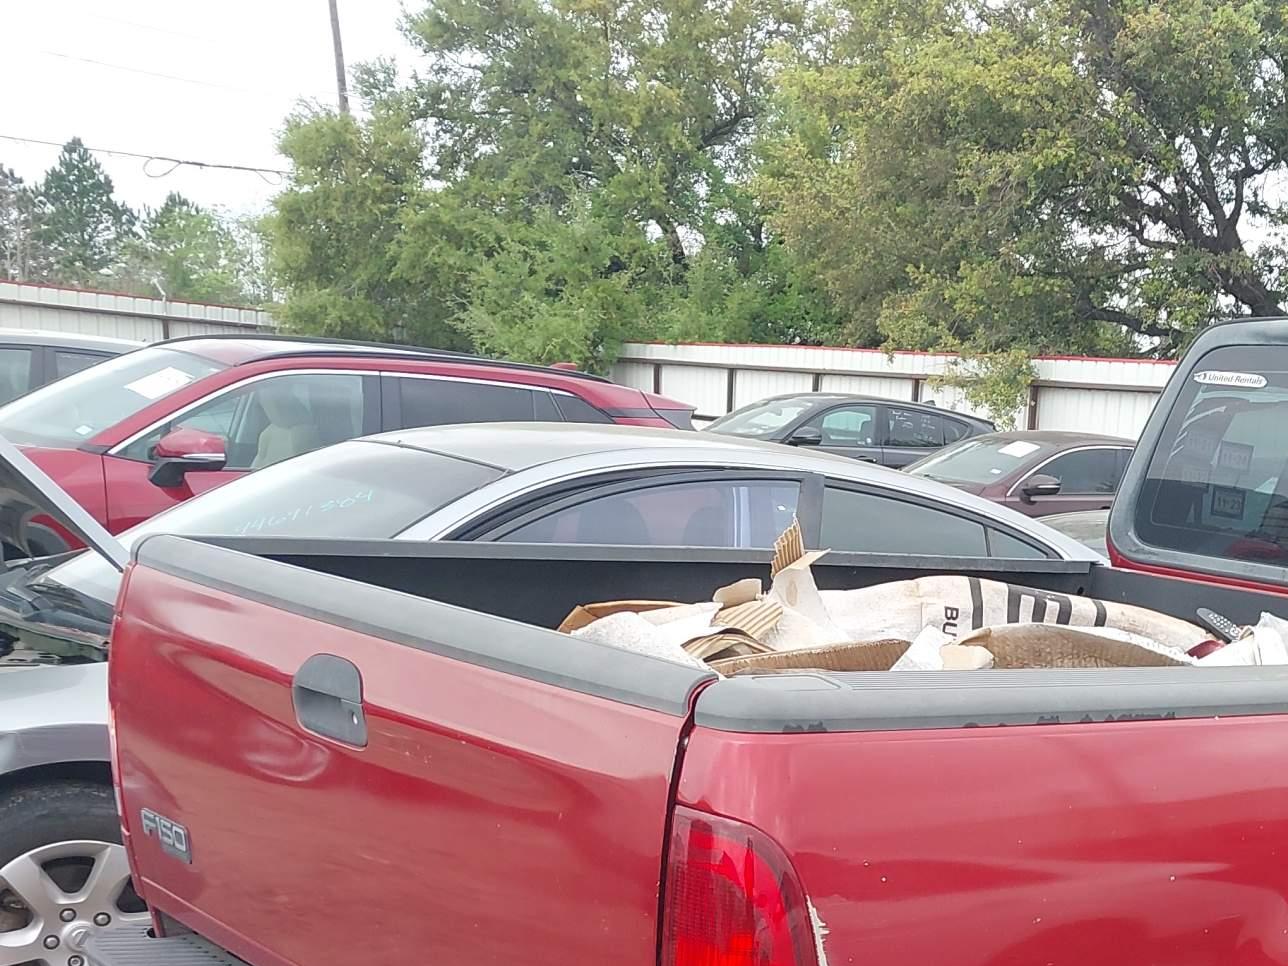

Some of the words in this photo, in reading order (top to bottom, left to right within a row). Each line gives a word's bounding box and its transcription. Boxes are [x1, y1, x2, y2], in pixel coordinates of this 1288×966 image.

[1208, 373, 1233, 383] United
[1235, 375, 1263, 385] Rentals
[942, 606, 959, 640] BU
[141, 809, 187, 852] F150
